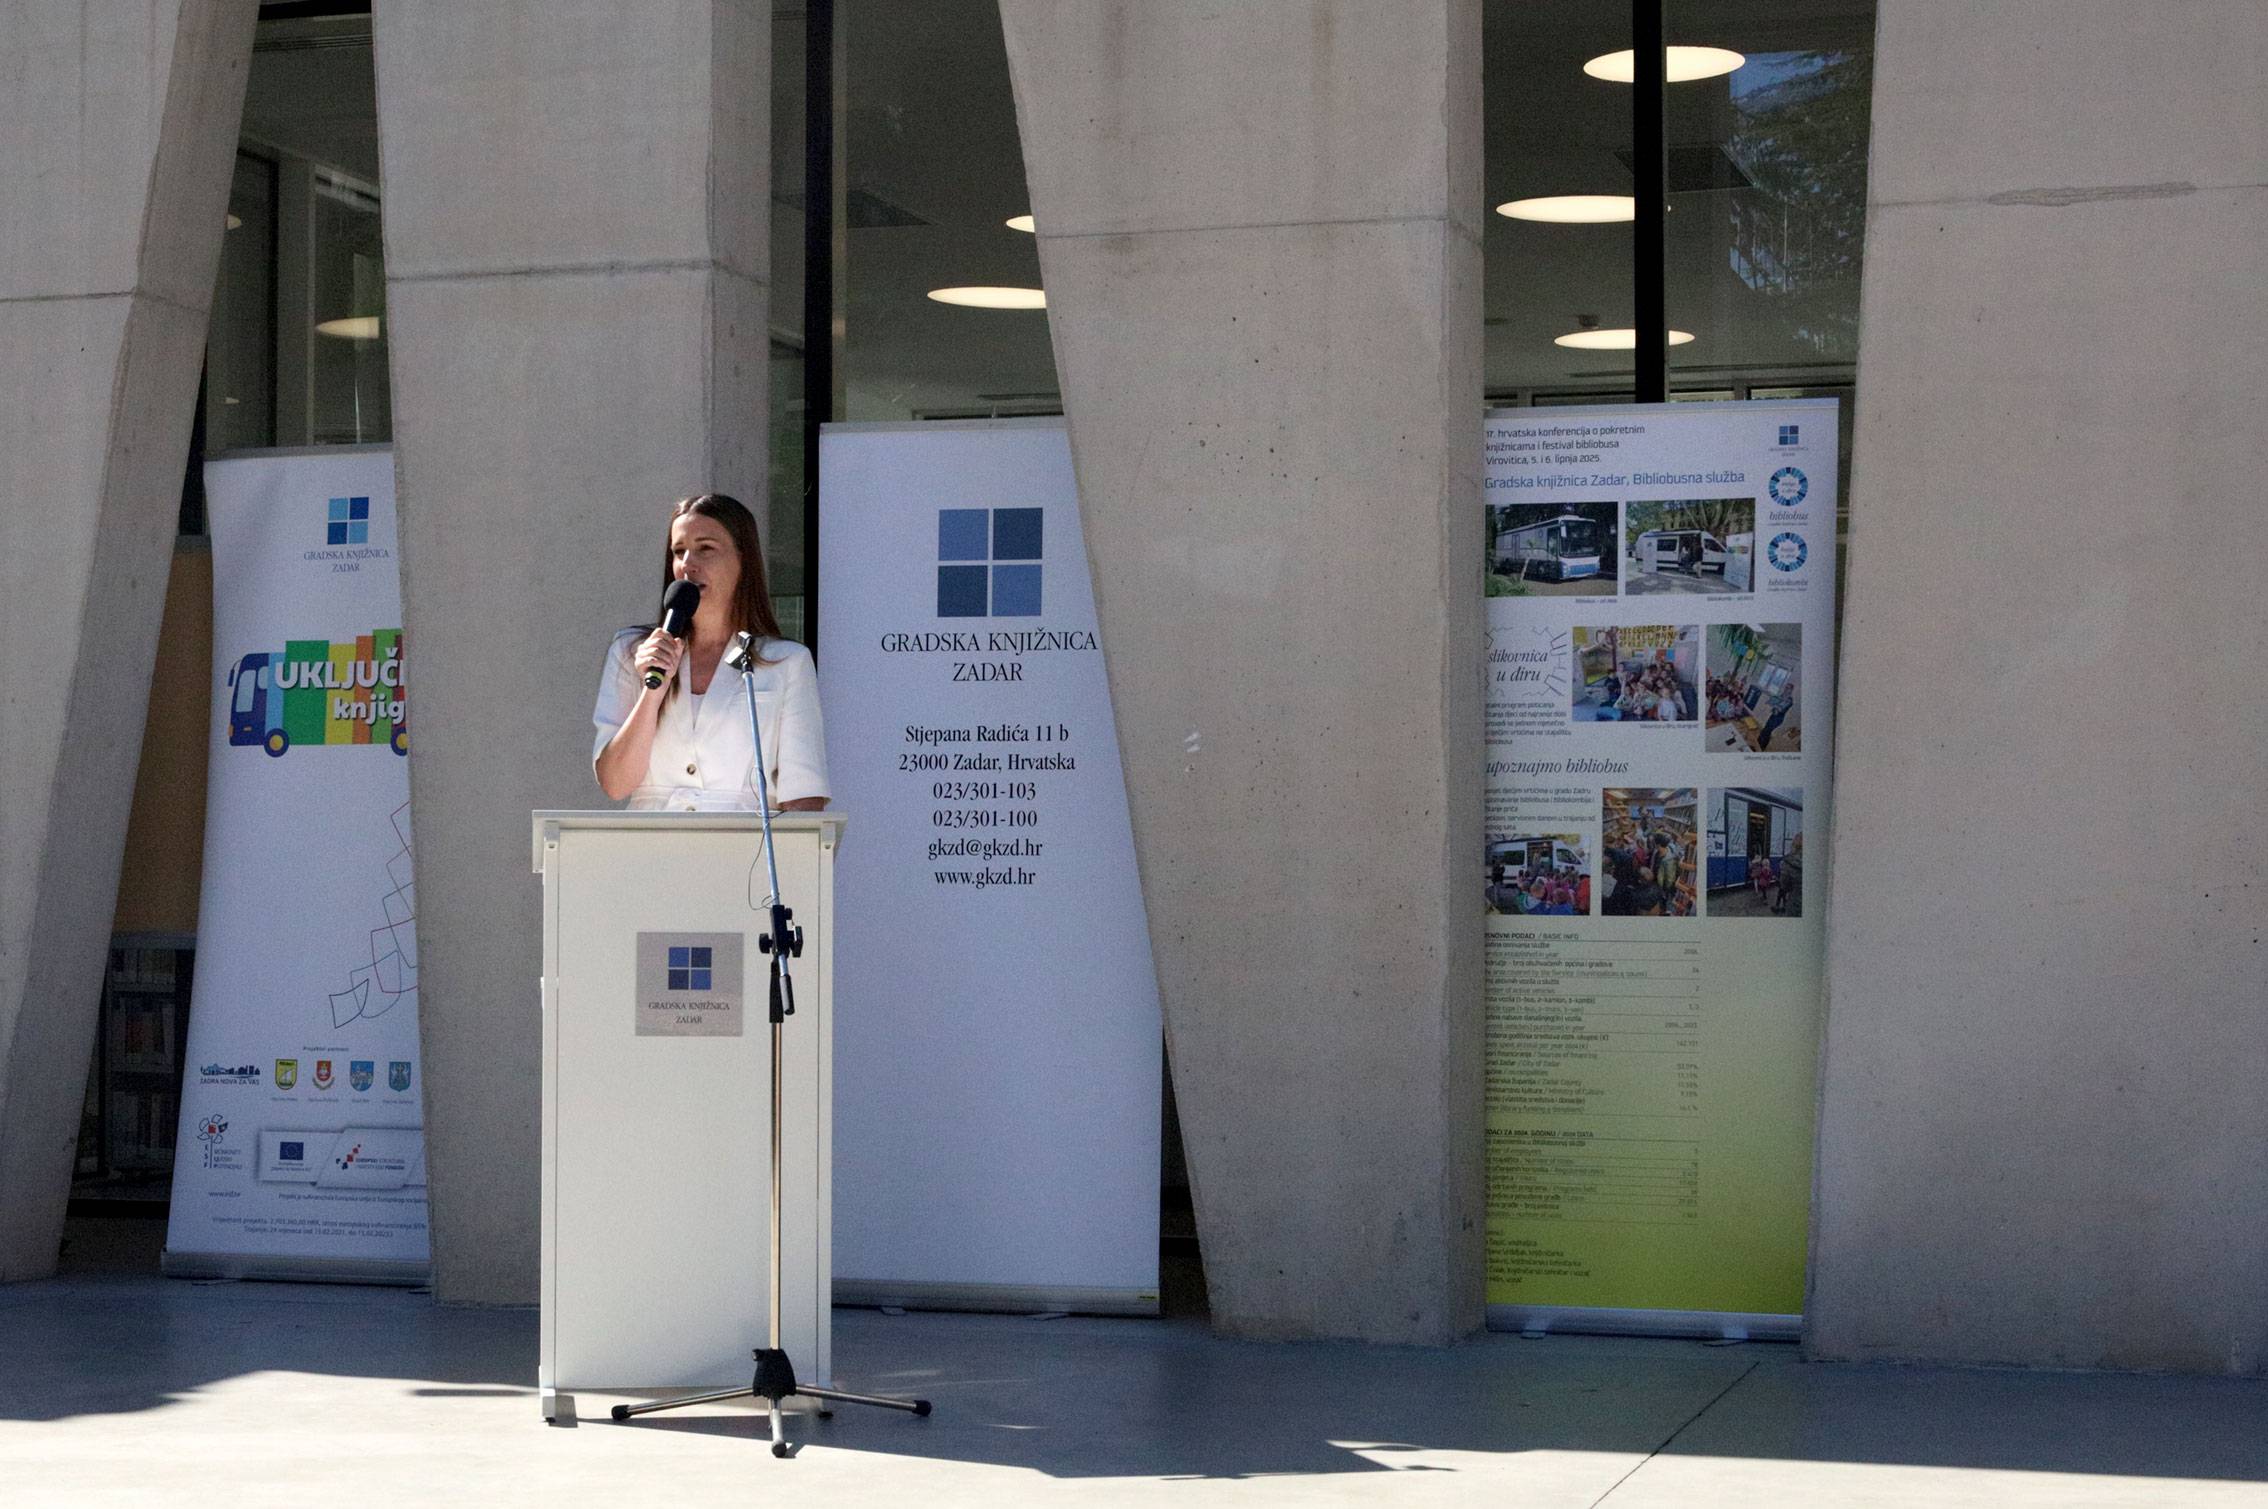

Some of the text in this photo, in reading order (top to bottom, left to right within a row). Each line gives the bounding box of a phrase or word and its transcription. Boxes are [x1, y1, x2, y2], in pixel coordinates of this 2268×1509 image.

[1497, 428, 1537, 438] hrvatska
[1538, 426, 1590, 437] konferencija
[1599, 425, 1645, 437] pokretnim
[1485, 441, 1535, 453] knjižnicama
[1542, 440, 1573, 450] festival
[1575, 439, 1619, 449] bibliobusa
[1486, 456, 1528, 465] Virovitica,
[1554, 454, 1578, 465] lipnja
[1484, 470, 1745, 490] Gradska knjižnica Zadar, Bibliobusna služba
[1769, 511, 1808, 521] bibliobus
[303, 547, 390, 561] GRADSKA KNJIŽNICA
[332, 562, 360, 573] ZADAR
[881, 627, 1099, 656] GRADSKA KNJIŽNICA
[1487, 649, 1549, 664] slikovnica
[952, 662, 1023, 682] ZADAR
[1496, 671, 1506, 682] u
[905, 724, 1069, 746] Stjepana Radića 11 b
[898, 752, 1076, 773] 23000 Zadar, Hrvatska
[1485, 758, 1629, 777] upoznajmo bibliobus
[933, 782, 1037, 800] 023/301-103
[933, 810, 1038, 828] 023/301-100
[928, 838, 1043, 861] gkzd@gkzd.hr
[934, 867, 1036, 889] www.gkzd.hr
[648, 1001, 686, 1011] GRADSKA
[675, 1015, 703, 1024] ZADAR
